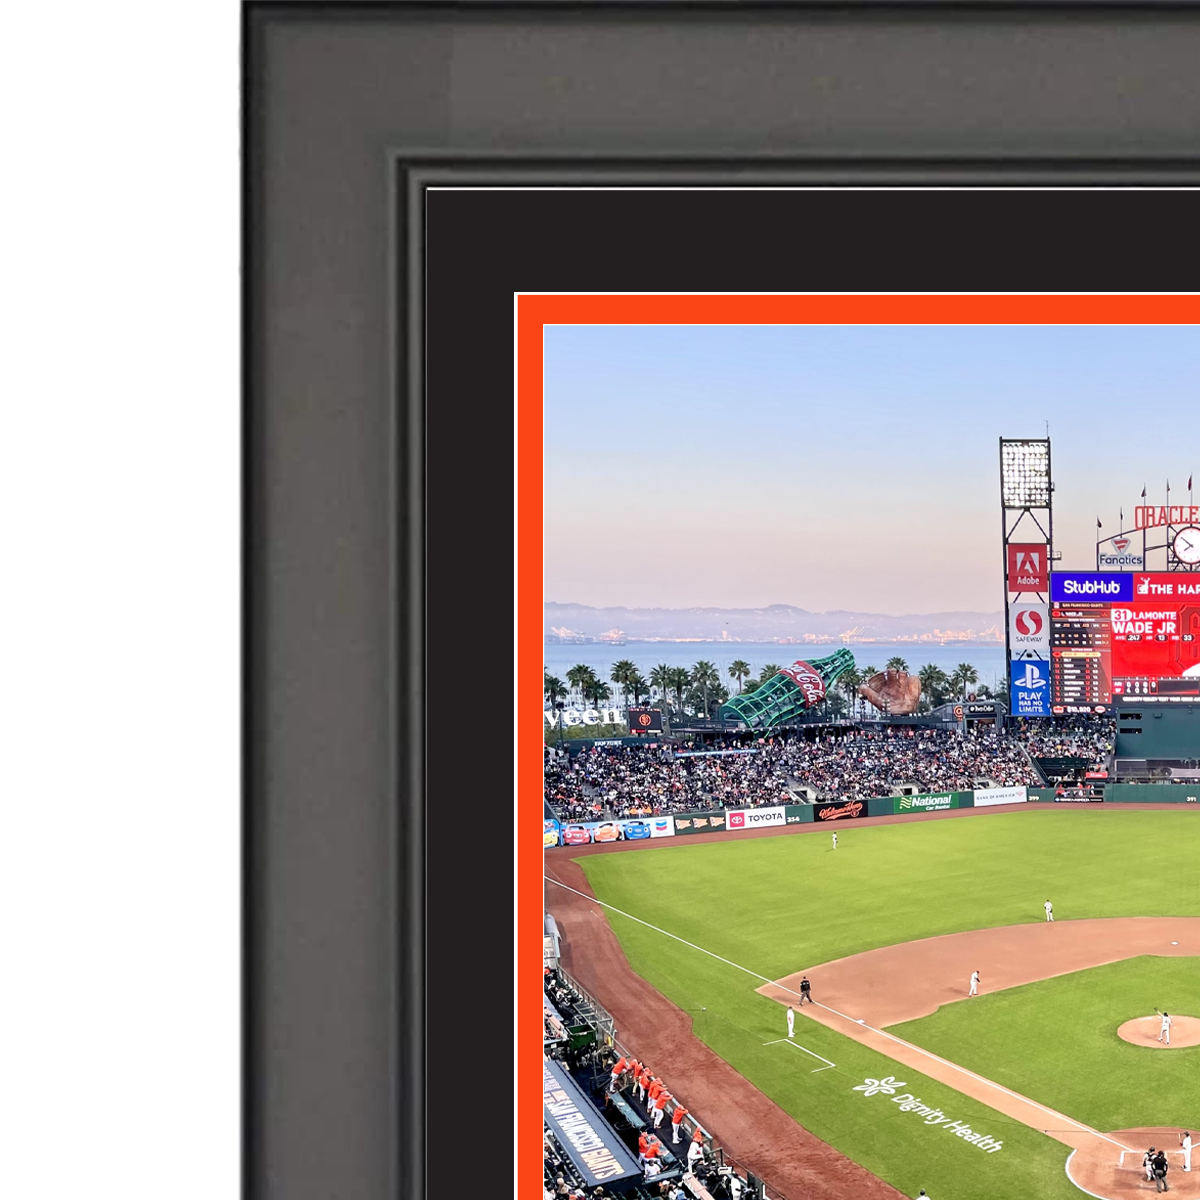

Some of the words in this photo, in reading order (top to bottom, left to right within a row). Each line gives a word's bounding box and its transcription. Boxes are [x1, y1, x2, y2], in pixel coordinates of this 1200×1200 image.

[1134, 505, 1199, 531] ORACLE
[1099, 554, 1143, 566] Fanatics
[1016, 576, 1040, 585] Adobe
[1063, 580, 1120, 594] StubHub
[1150, 584, 1174, 594] THE
[1114, 610, 1128, 621] 31
[1132, 612, 1177, 620] LAMONTE
[1112, 622, 1153, 634] WADE
[1156, 622, 1176, 634] JR
[1018, 692, 1042, 700] PLAY
[912, 794, 952, 808] National
[748, 812, 783, 823] TOYOTA
[891, 1094, 950, 1125] Dignity
[943, 1120, 1004, 1154] Health
[554, 1112, 606, 1152] FRANCISCO
[580, 1148, 626, 1180] GIANTS
